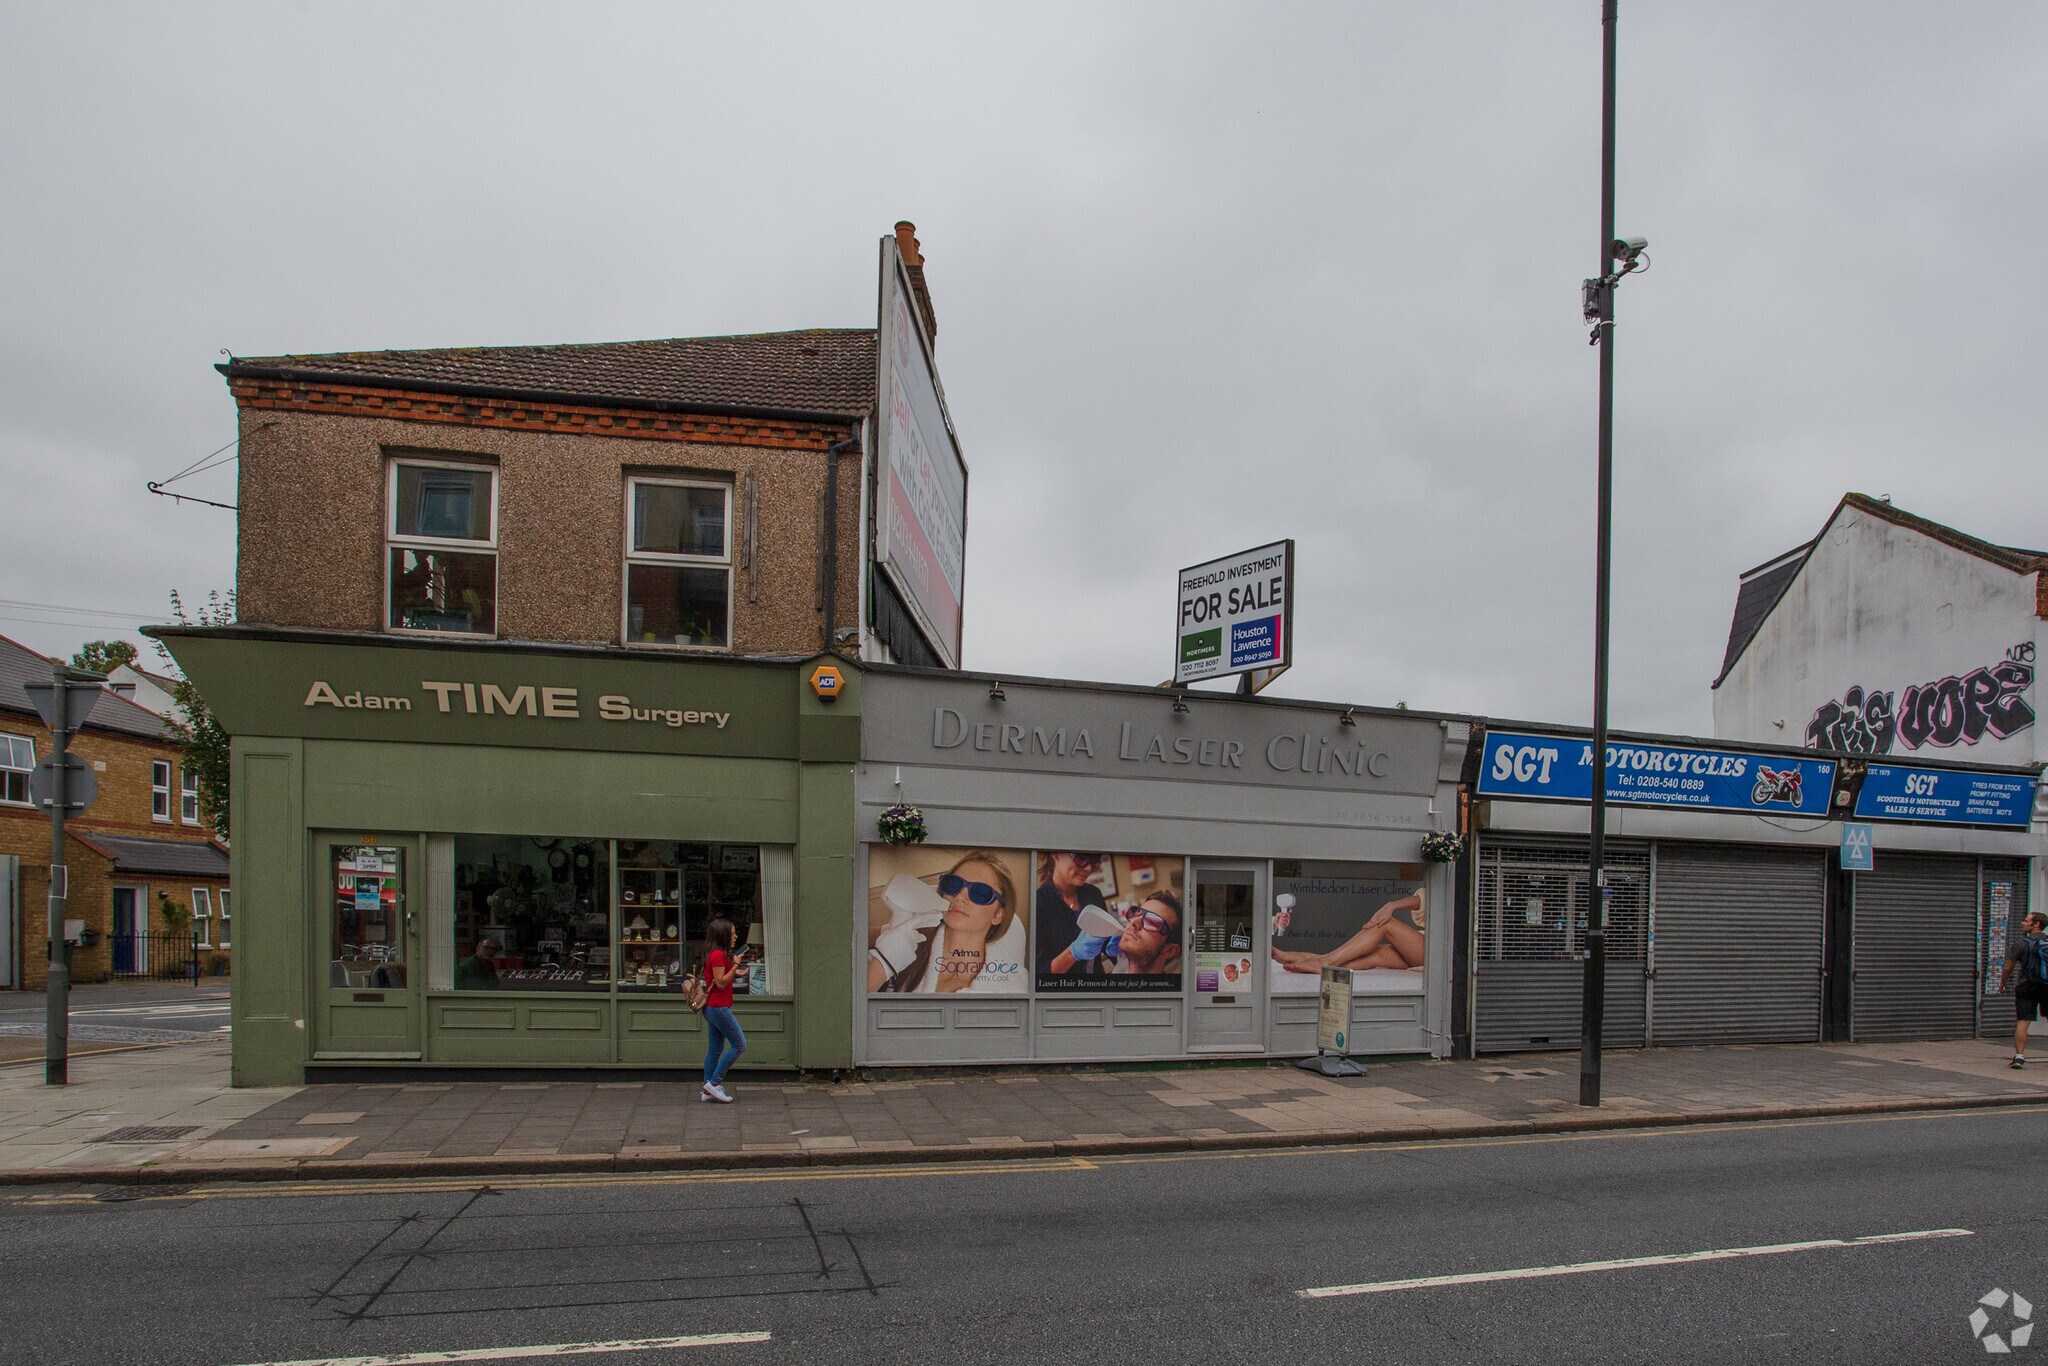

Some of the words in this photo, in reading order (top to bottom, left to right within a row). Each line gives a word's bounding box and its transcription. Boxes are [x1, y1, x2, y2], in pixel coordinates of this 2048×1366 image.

[893, 379, 910, 444] Sell
[911, 429, 919, 464] or
[920, 445, 931, 494] Let
[931, 477, 945, 522] your
[945, 506, 961, 564] home
[899, 445, 917, 510] with
[918, 487, 935, 547] Cribs
[936, 525, 956, 591] Estates
[1182, 570, 1226, 593] FREEHOLD
[1227, 554, 1283, 580] INVESTMENT
[1181, 592, 1222, 627] FOR
[1227, 576, 1282, 615] SALE
[1233, 626, 1267, 641] Houston
[1186, 645, 1215, 657] MORTIMERS
[1233, 637, 1272, 652] Lawrence
[1232, 656, 1244, 664] 020
[1244, 653, 1258, 662] 8947
[1258, 650, 1272, 660] 5050
[1181, 664, 1193, 672] 020
[1193, 661, 1205, 669] 7112
[1205, 658, 1219, 667] 8097
[820, 678, 835, 686] ADT
[2012, 671, 2025, 682] 17
[304, 681, 412, 711] Adam
[421, 681, 580, 718] TIME
[600, 695, 731, 729] Surgery
[933, 707, 1095, 758] DERMA
[1119, 721, 1244, 769] LASER
[1492, 744, 1559, 784] SGT
[1578, 745, 1748, 778] MOTORCYCLES
[1817, 764, 1831, 774] 160
[1879, 769, 1891, 777] 1979
[1618, 774, 1635, 786] Tel:
[1637, 775, 1679, 789] 0208-540
[1680, 778, 1705, 791] 0889
[1904, 773, 1939, 796] SGT
[1972, 781, 1988, 789] TYRES
[1988, 782, 2004, 790] FROM
[1606, 789, 1711, 803] www.sgtmotorcycles.co.uk
[1877, 795, 1909, 805] SCOOTERS
[1909, 797, 1916, 805] &
[1916, 798, 1961, 808] MOTORCYCLES
[1990, 791, 2011, 799] FITTING
[1968, 798, 1985, 806] BRAKE
[1985, 799, 2000, 807] PADS
[1884, 805, 1908, 814] SALES
[1916, 807, 1947, 816] SERVICE
[1966, 806, 1993, 815] BATTERIES
[1290, 880, 1349, 894] Wimbledon
[1351, 883, 1381, 895] Laser
[1383, 881, 1412, 895] Clinic
[1232, 940, 1248, 948] OPEN
[952, 949, 980, 957] Alma
[1038, 979, 1058, 987] Laser
[1059, 979, 1076, 987] Hair
[1077, 979, 1108, 987] Removal
[1126, 979, 1139, 989] just
[1138, 979, 1148, 989] for
